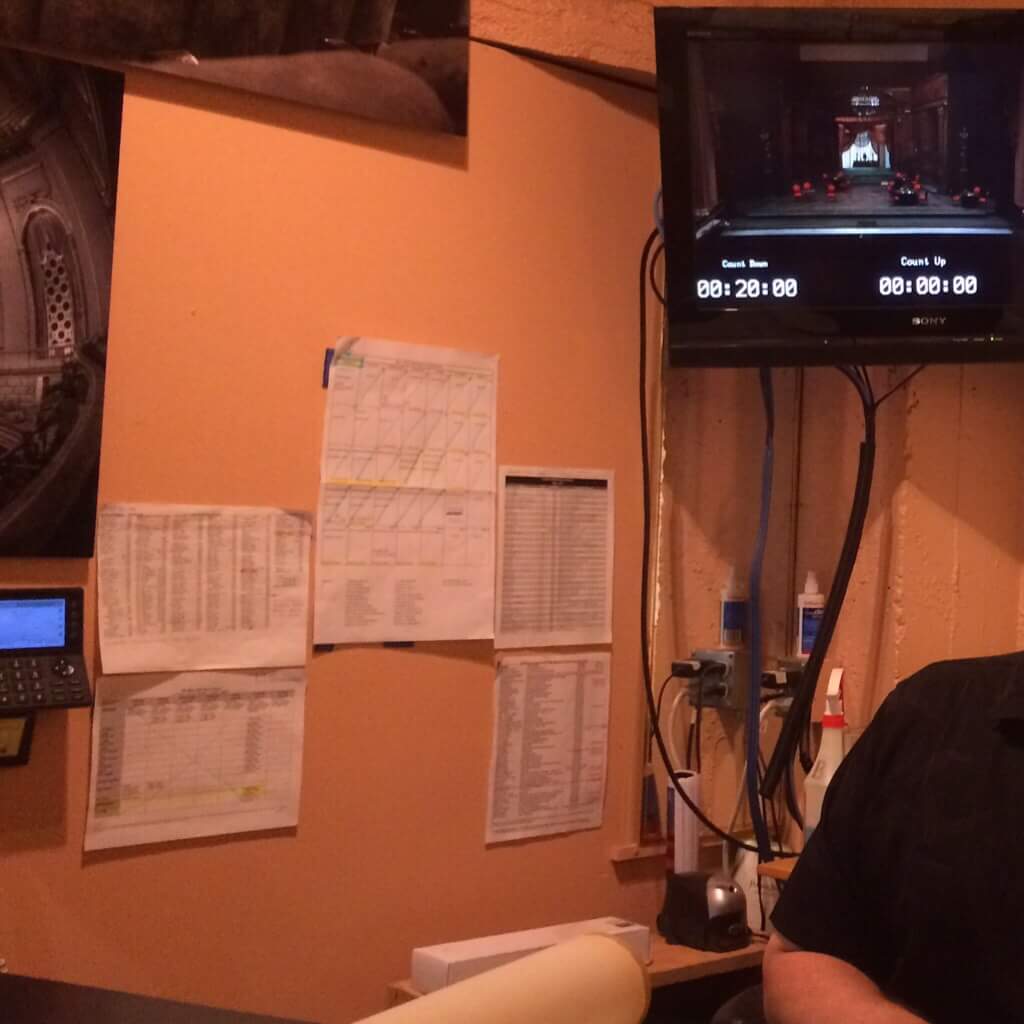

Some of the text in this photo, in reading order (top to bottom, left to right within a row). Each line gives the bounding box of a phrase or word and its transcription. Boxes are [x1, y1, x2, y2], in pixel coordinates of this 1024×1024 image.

[721, 259, 746, 268] Count
[901, 256, 947, 267] Count Up
[697, 278, 798, 298] 00:20:00
[879, 275, 978, 295] 00:00:00
[912, 317, 946, 325] SONY
